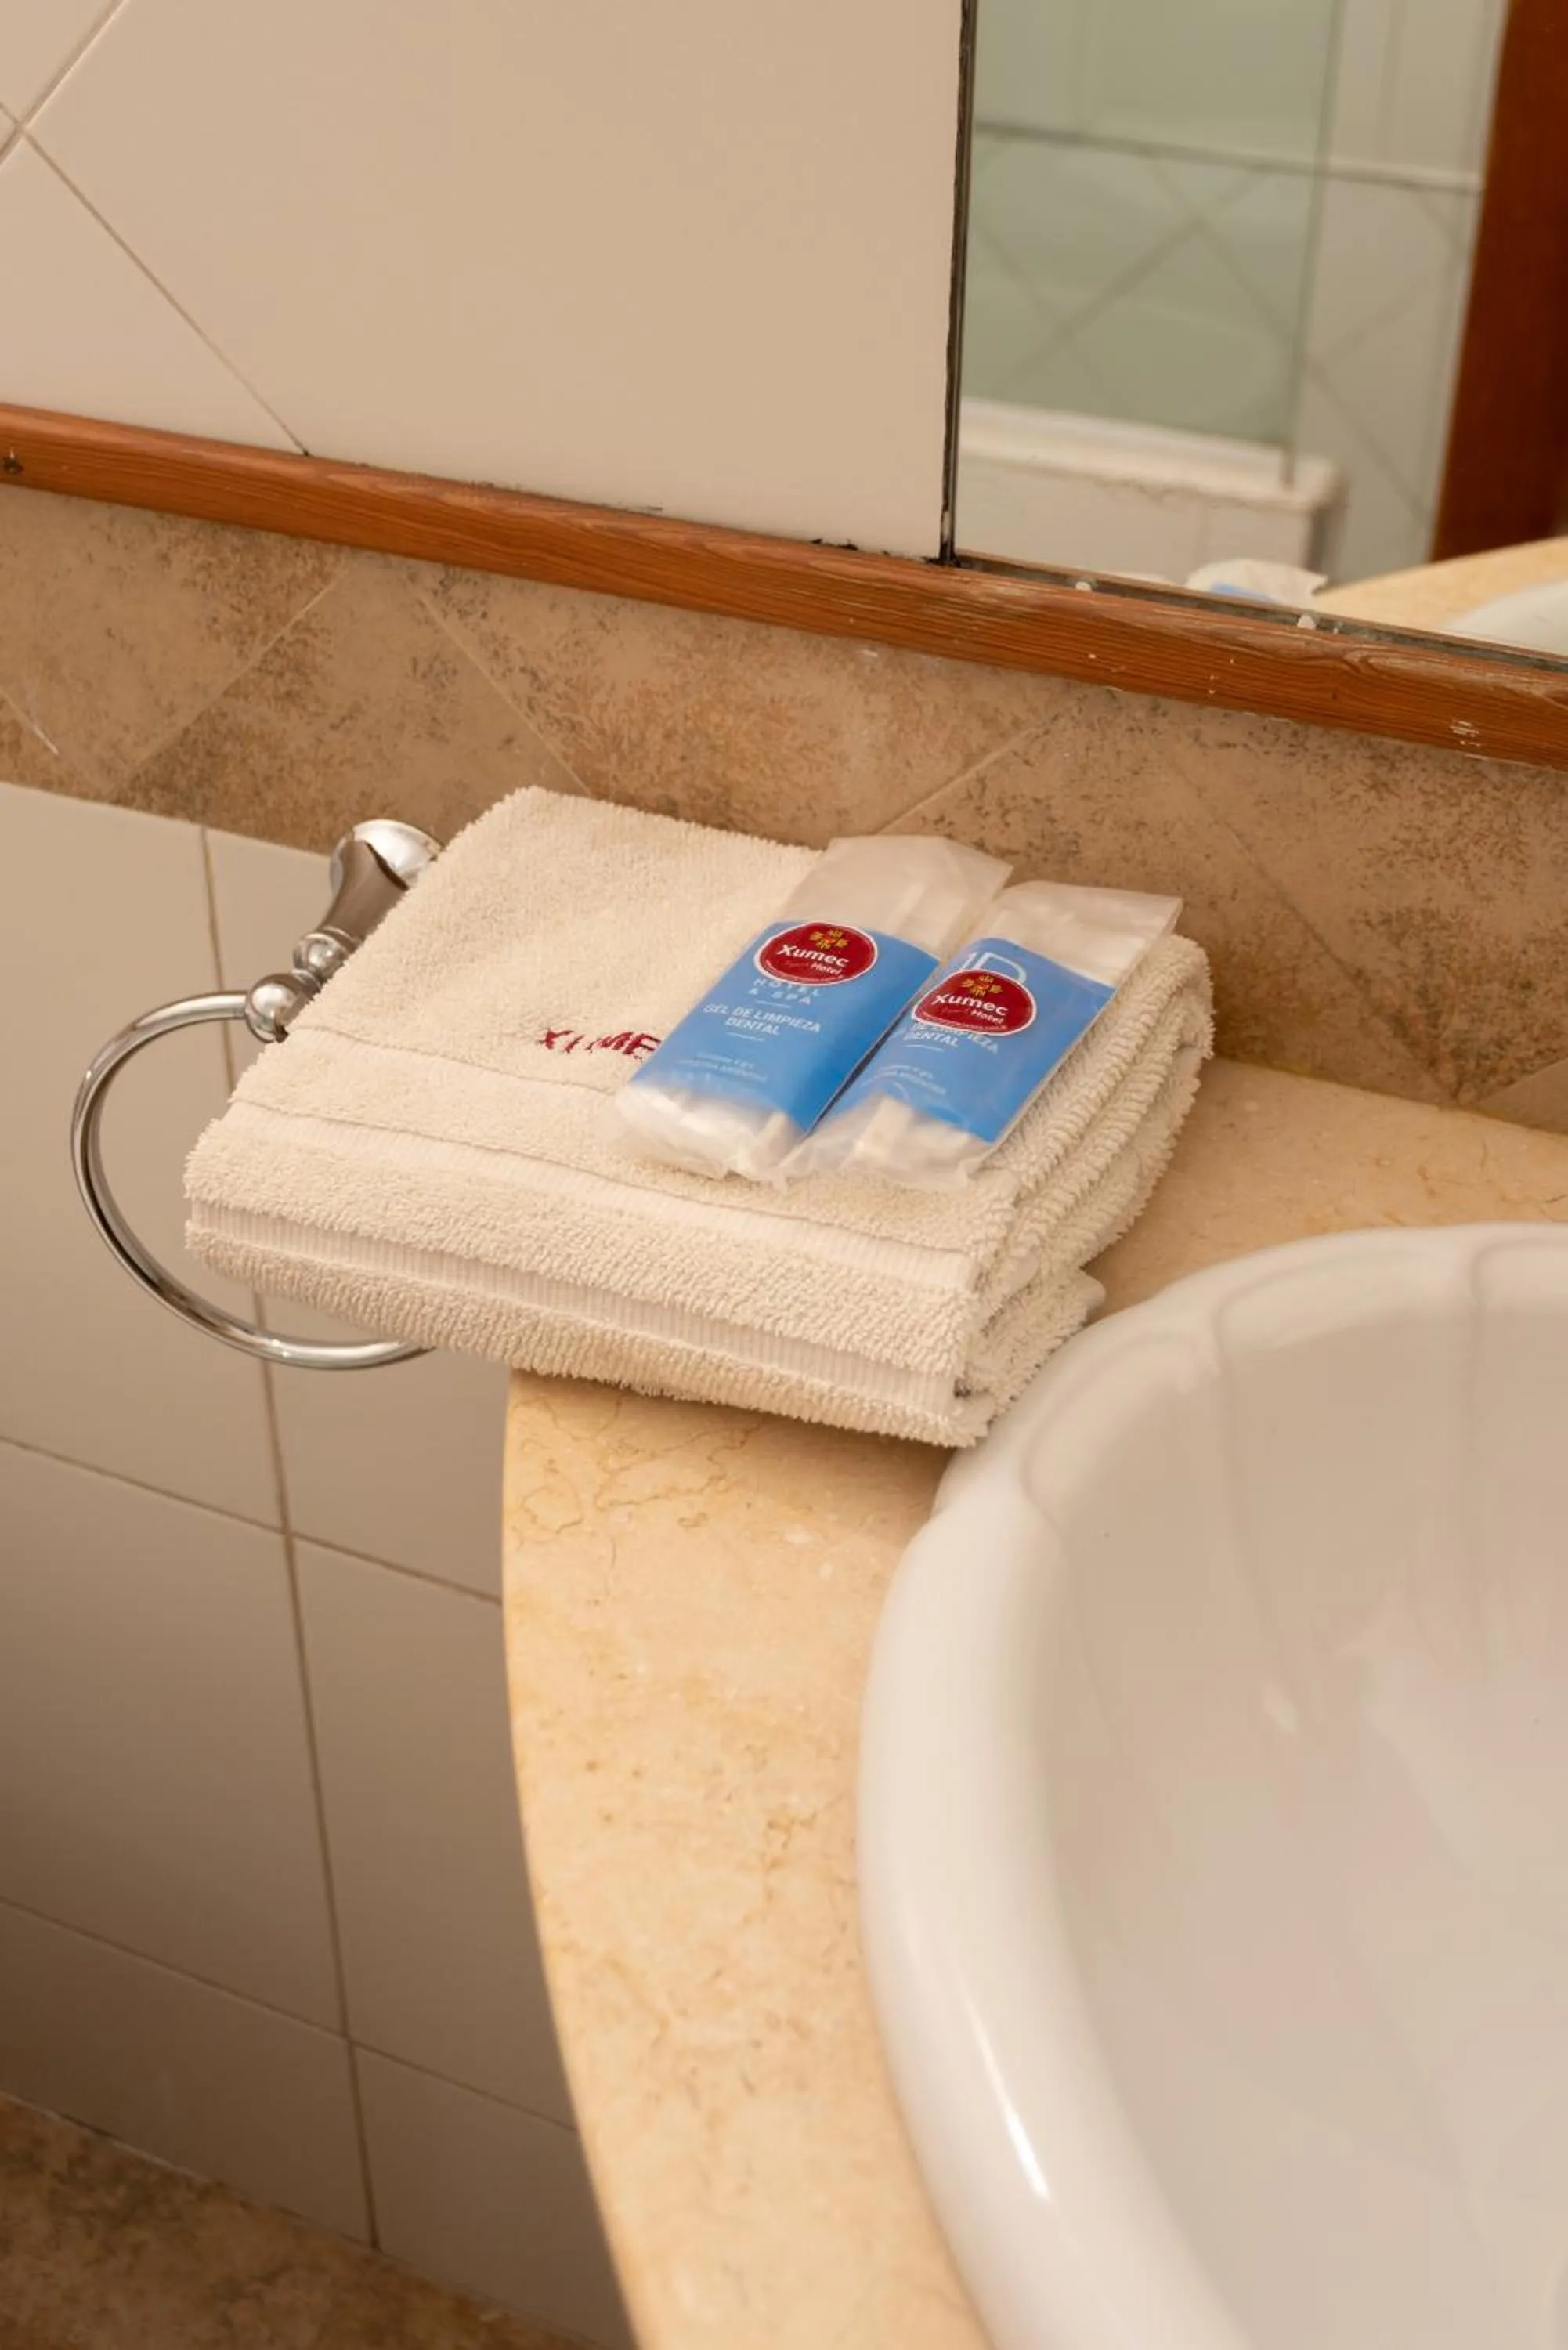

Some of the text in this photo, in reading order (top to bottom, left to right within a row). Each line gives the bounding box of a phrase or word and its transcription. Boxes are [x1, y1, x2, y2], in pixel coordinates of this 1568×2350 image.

[777, 944, 849, 967] Xumec
[931, 993, 1010, 1017] Xumec
[724, 1017, 780, 1035] DENTAL
[732, 1006, 753, 1017] DE
[753, 1010, 822, 1033] LIMPIEZA
[539, 1028, 662, 1061] XUME
